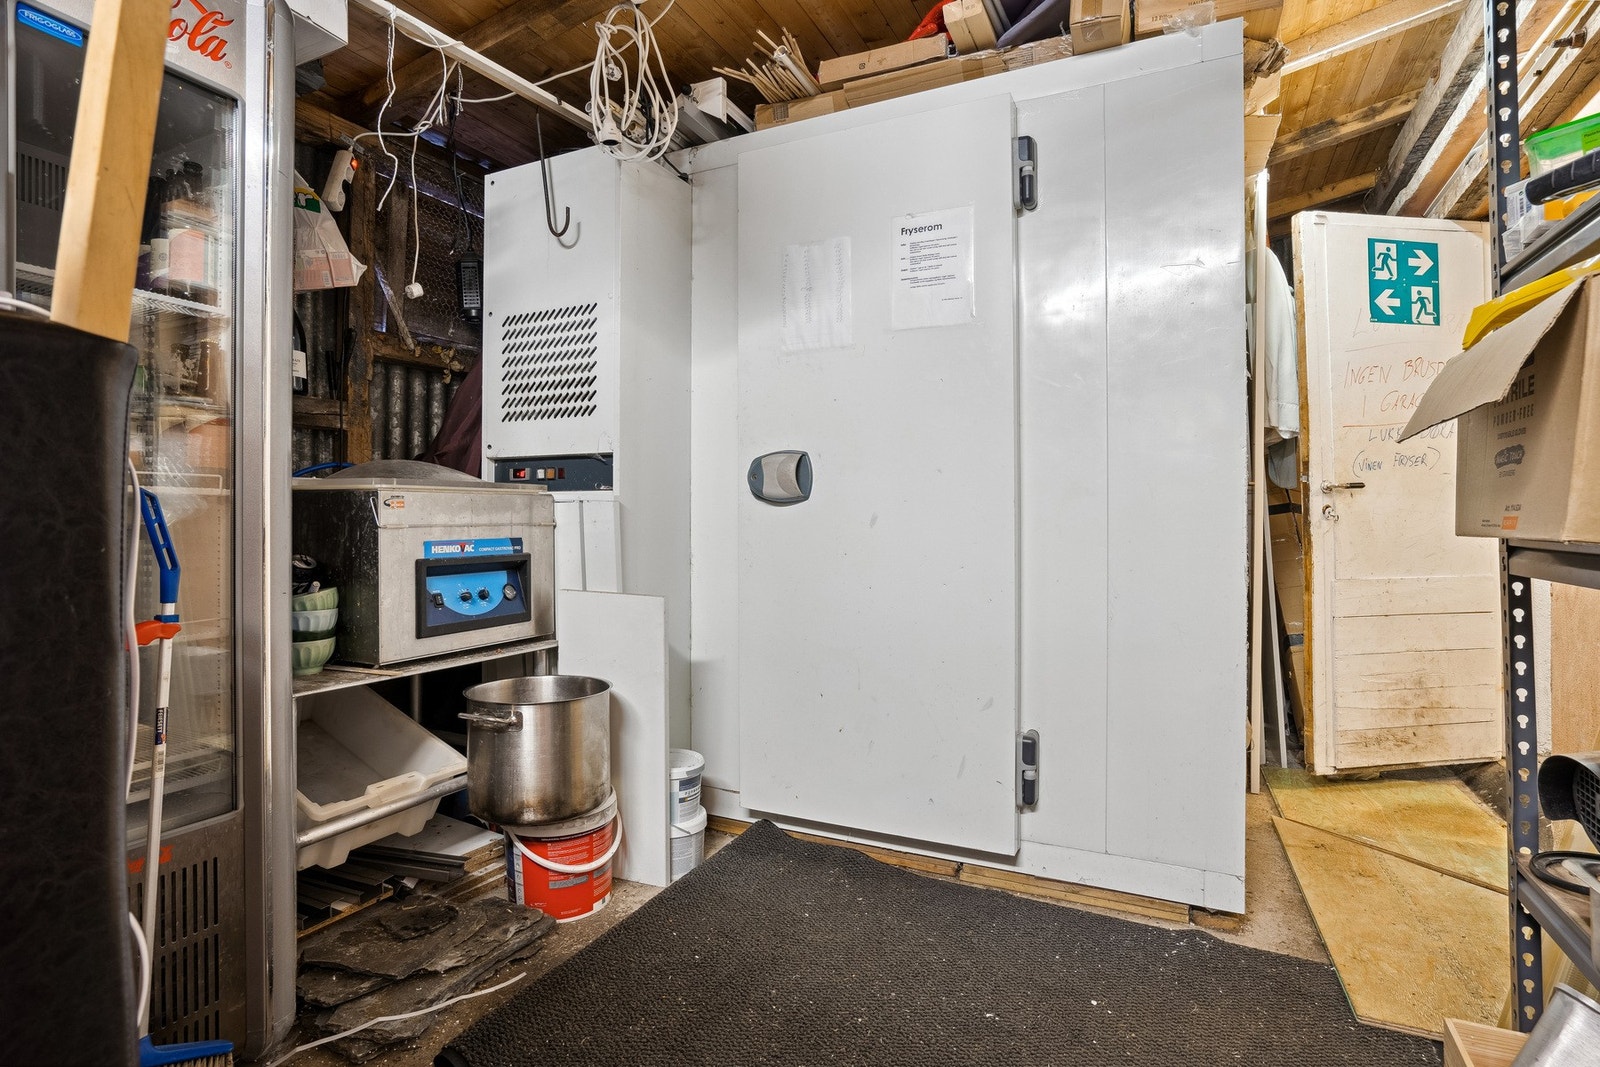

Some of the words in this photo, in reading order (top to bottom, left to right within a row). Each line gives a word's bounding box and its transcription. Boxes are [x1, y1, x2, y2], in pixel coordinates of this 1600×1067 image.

[25, 10, 76, 38] FRIGOGLASS
[167, 11, 234, 61] ola
[901, 223, 943, 236] Fryserom
[1344, 361, 1392, 389] INGEN
[1493, 374, 1535, 408] RILE
[431, 543, 475, 555] HENKOVAC
